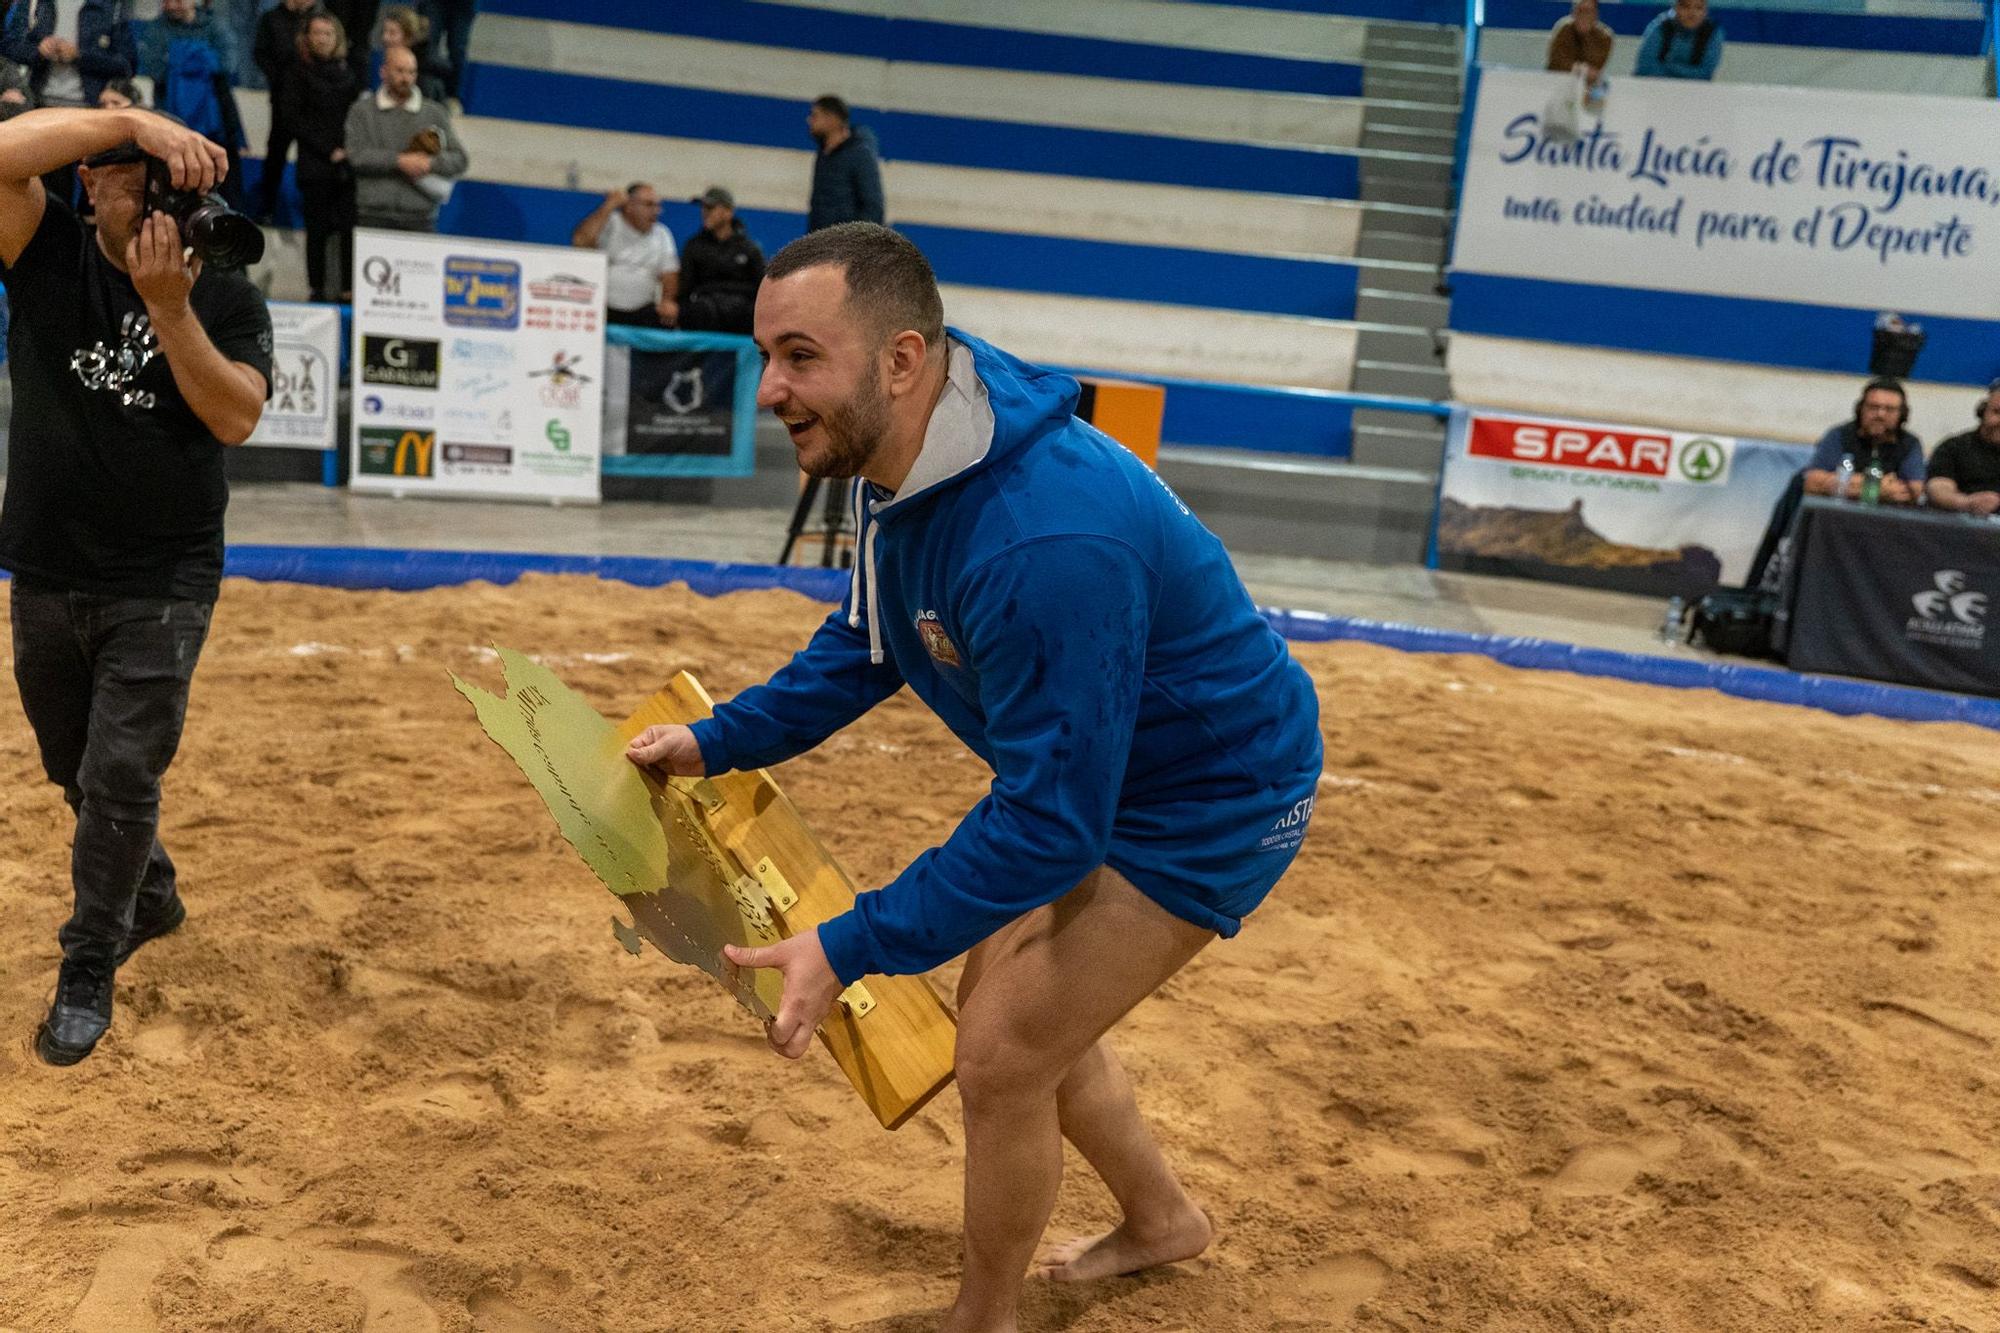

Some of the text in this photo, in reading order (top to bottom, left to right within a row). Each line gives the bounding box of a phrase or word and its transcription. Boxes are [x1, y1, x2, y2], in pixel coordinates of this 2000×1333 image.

[1500, 113, 2000, 214] Santa Lucía de Tirajana,
[1572, 193, 1685, 236] ciudad
[1695, 208, 1781, 248] para
[1792, 206, 1822, 248] el
[1828, 201, 1975, 264] Deporte
[1512, 426, 1668, 472] SPAR
